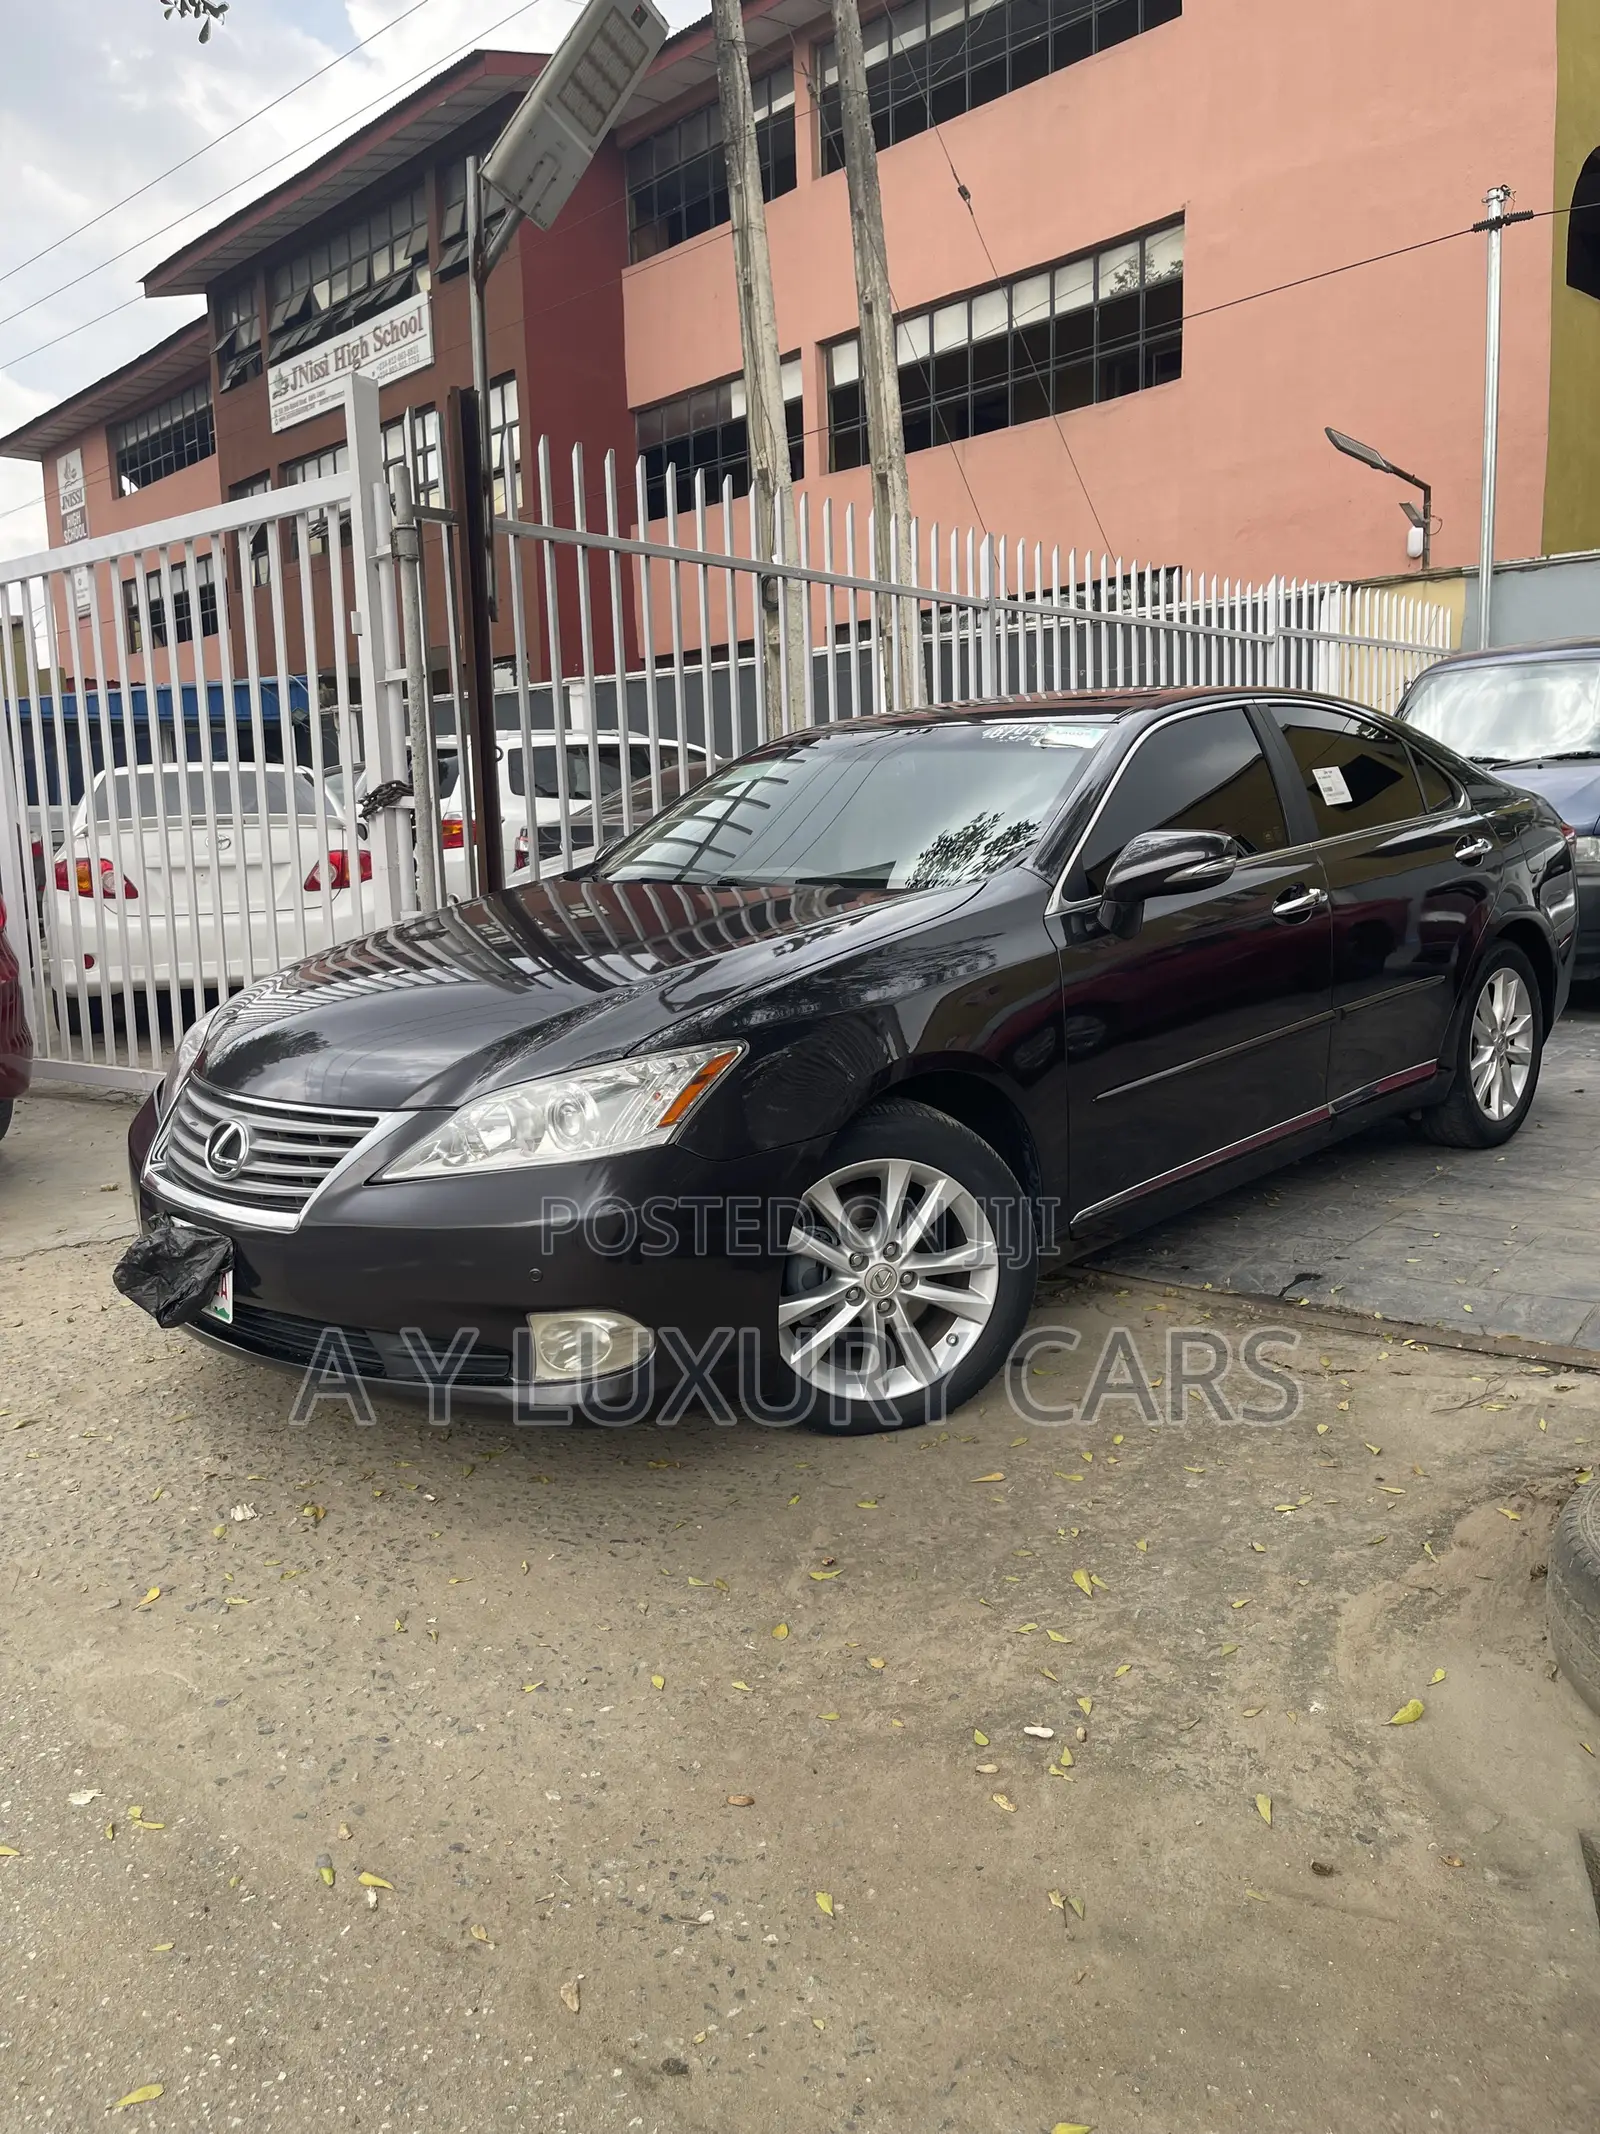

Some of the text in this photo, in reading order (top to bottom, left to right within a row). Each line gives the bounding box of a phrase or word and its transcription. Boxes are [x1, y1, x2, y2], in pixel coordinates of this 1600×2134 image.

[333, 335, 370, 371] High
[372, 306, 424, 353] School
[66, 511, 82, 529] HIGH
[63, 523, 88, 545] SCHOOL
